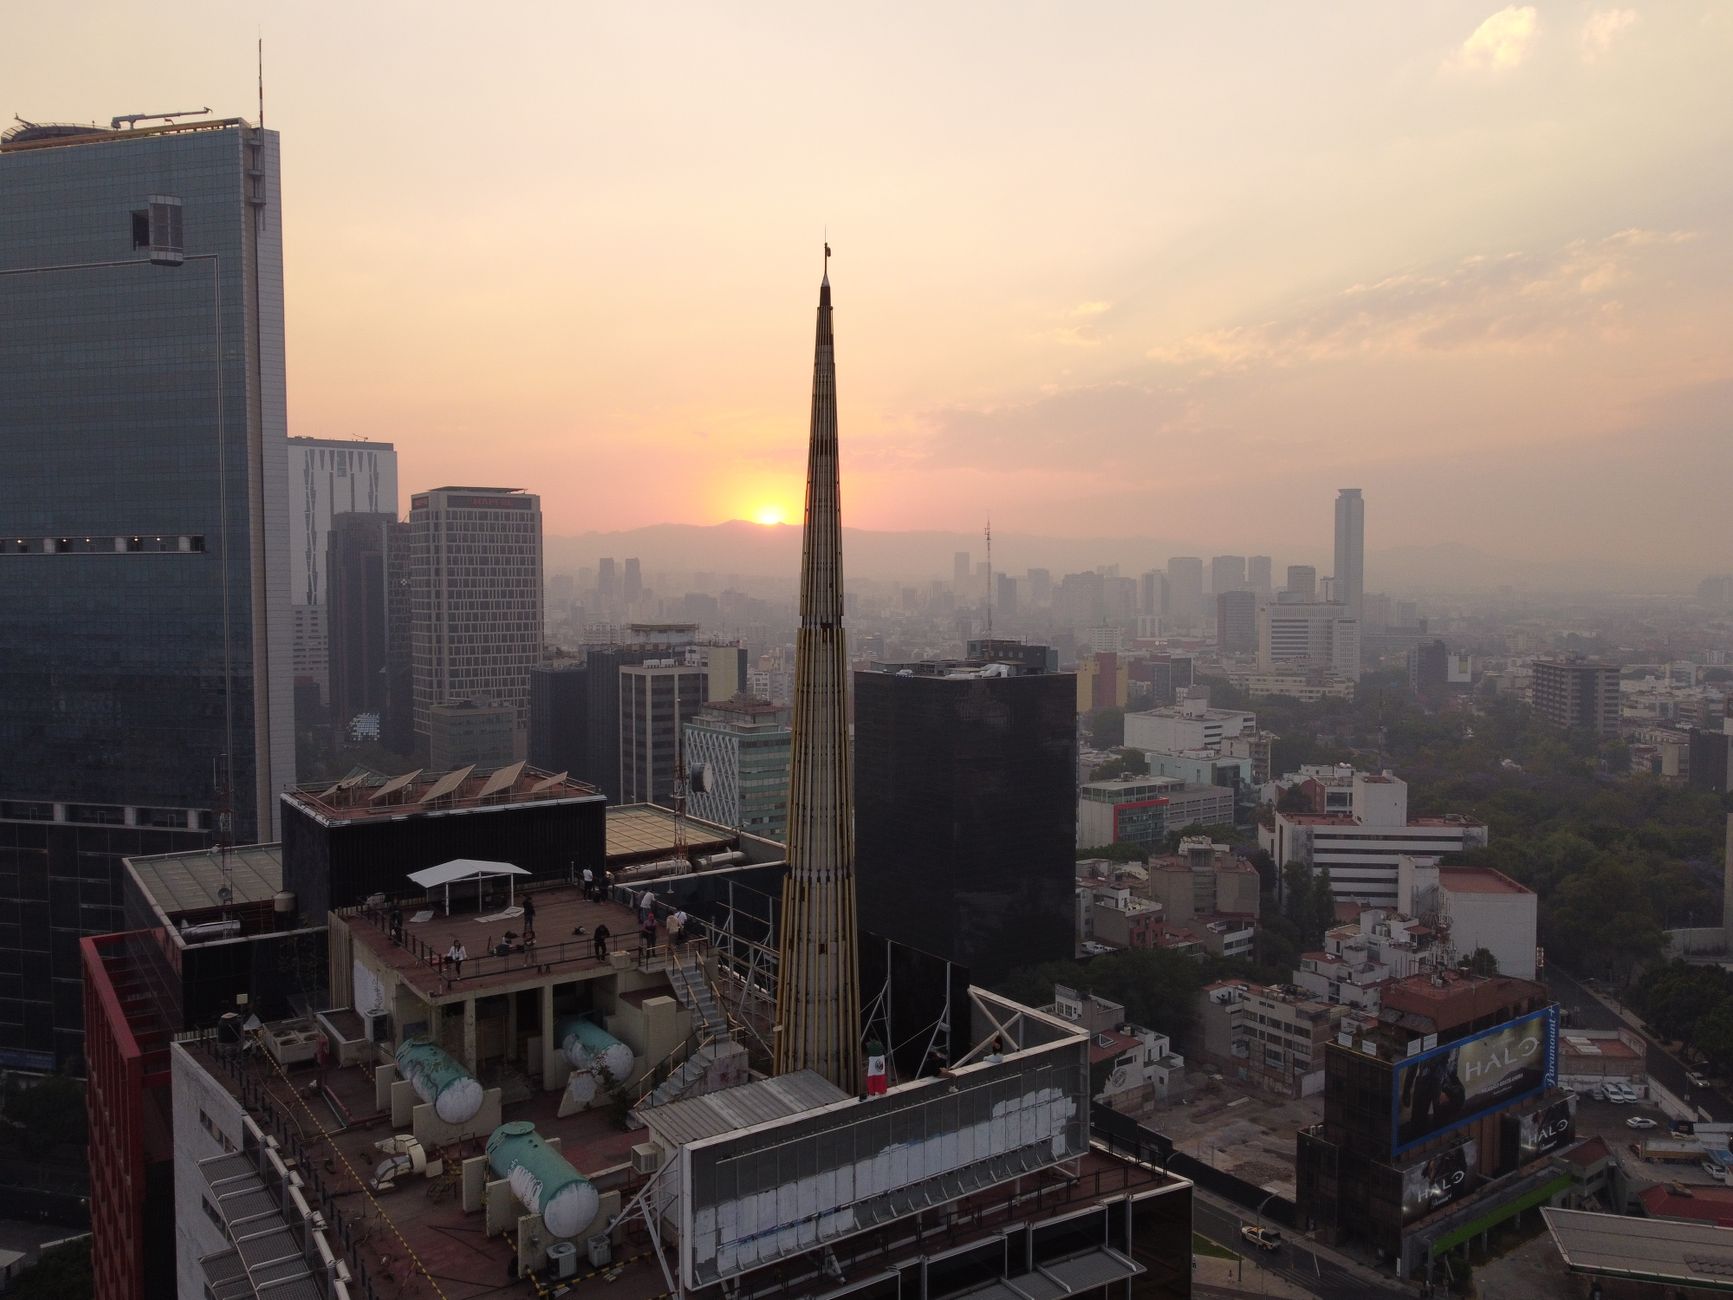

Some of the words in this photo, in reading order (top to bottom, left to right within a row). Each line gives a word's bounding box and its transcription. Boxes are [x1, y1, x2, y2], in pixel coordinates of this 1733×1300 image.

[1465, 1037, 1540, 1082] HALO
[1529, 1119, 1568, 1147] HALO
[1418, 1170, 1465, 1203] HALO
